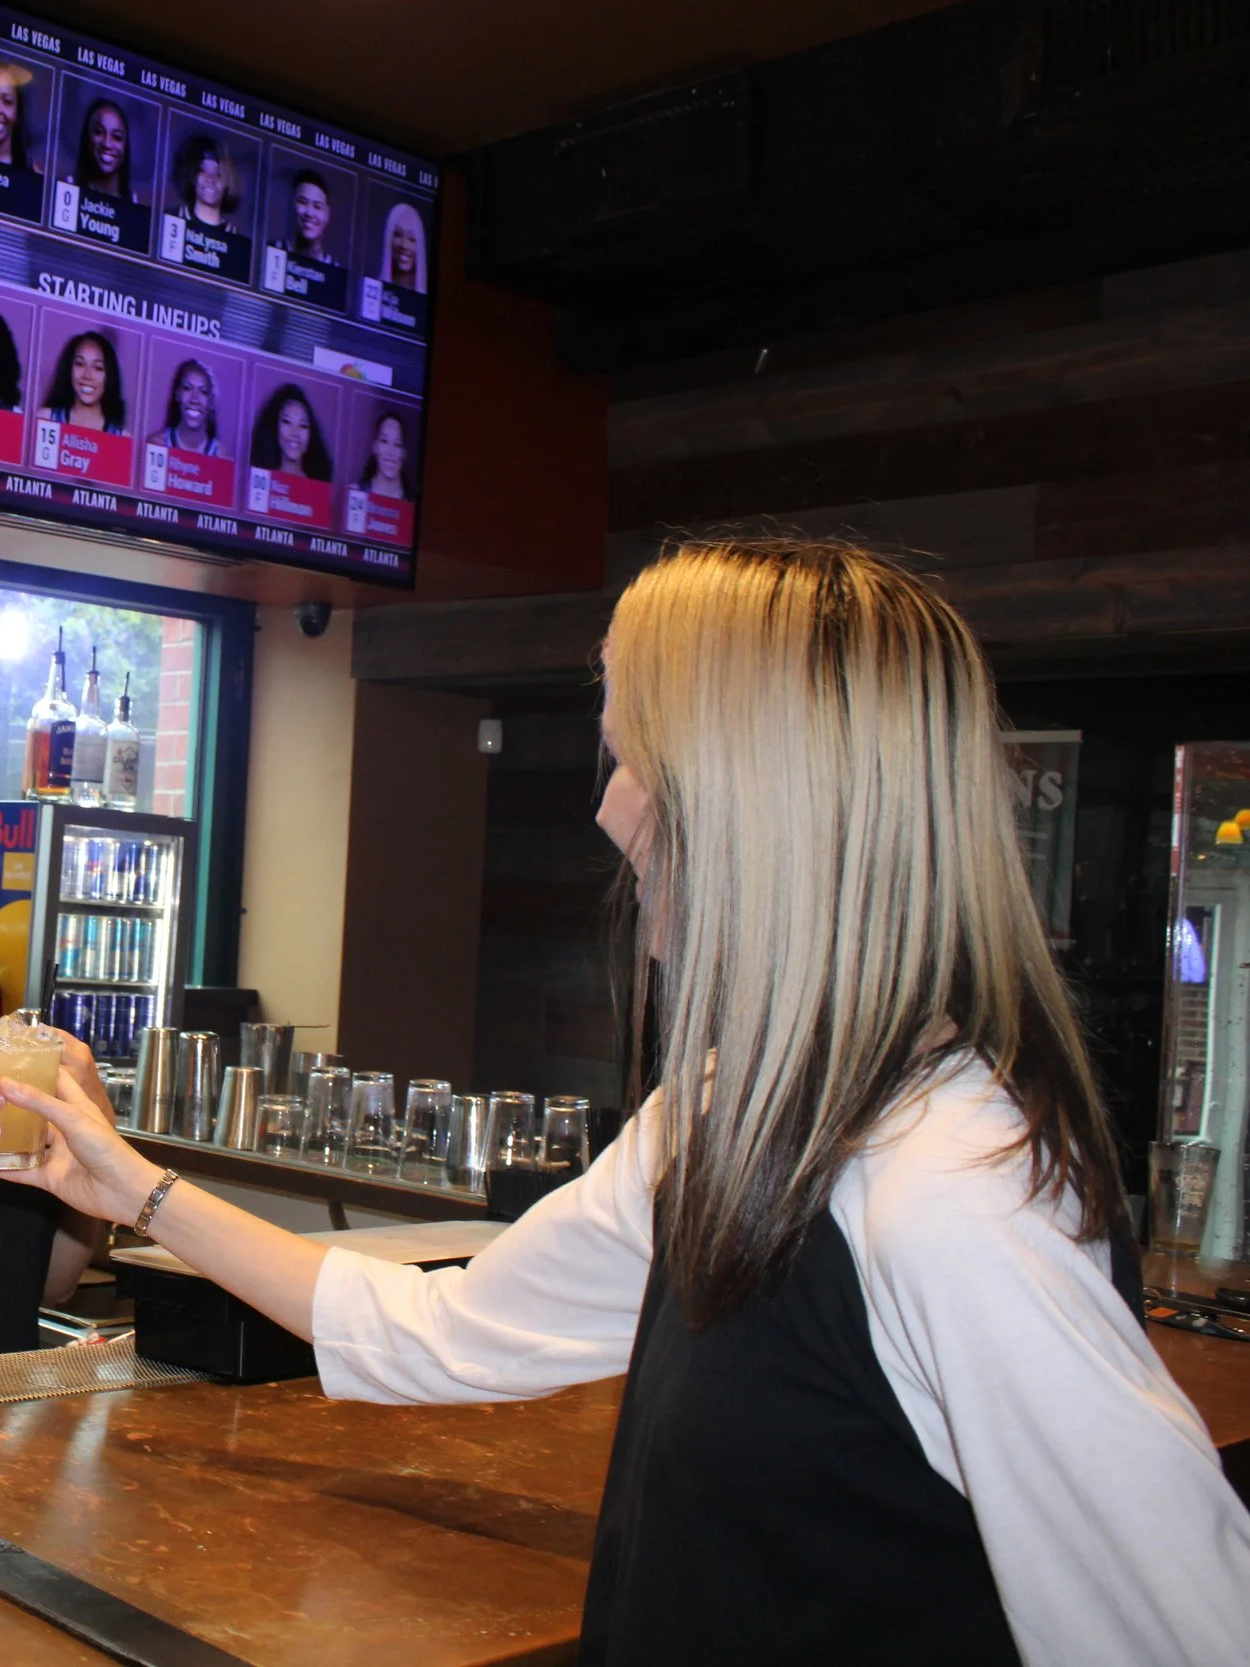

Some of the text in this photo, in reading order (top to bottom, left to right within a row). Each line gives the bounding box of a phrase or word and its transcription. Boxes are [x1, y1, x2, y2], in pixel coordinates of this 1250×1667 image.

[12, 23, 61, 54] LAS VEGAS
[78, 46, 125, 76] LAS VEGAS
[141, 70, 187, 98] LAS VEGAS
[202, 90, 246, 119] LAS VEGAS
[260, 112, 302, 139] LAS VEGAS
[315, 132, 355, 159] LAS VEGAS
[368, 151, 407, 177] LAS VEGAS
[80, 197, 116, 219] Jackie
[80, 213, 120, 243] Young
[37, 272, 222, 340] STARTING LINEUPS
[40, 427, 57, 445] 15
[60, 449, 90, 473] Gray
[6, 475, 53, 500] ATLANTA
[167, 475, 213, 497] Howard
[72, 488, 118, 512] ATLANTA
[136, 502, 179, 524] ATLANTA
[197, 514, 238, 535] ATLANTA
[254, 526, 294, 547] ATLANTA
[310, 537, 348, 557] ATLANTA
[363, 548, 399, 568] ATLANTA
